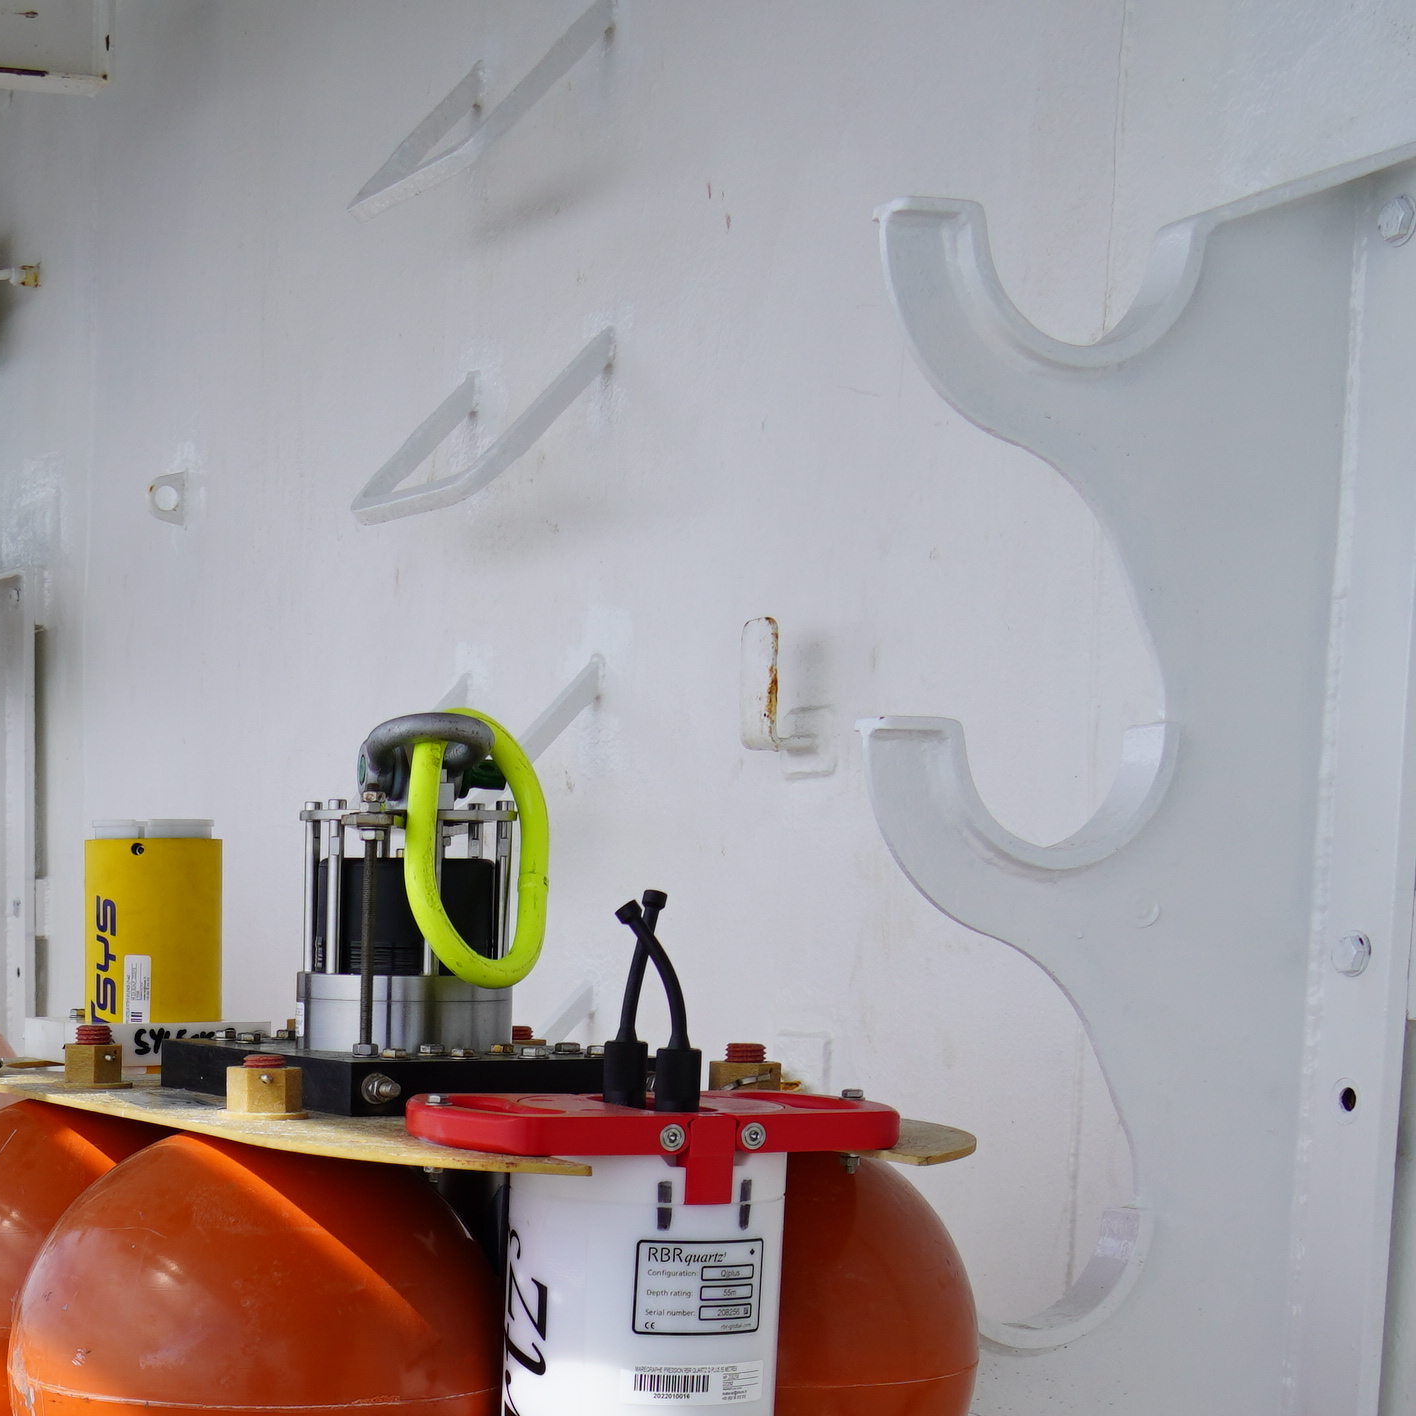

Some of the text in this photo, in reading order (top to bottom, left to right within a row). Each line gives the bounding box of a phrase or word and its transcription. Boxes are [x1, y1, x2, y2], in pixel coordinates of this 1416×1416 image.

[647, 1269, 699, 1278] Configuration:
[646, 1289, 694, 1299] Depth rating:
[722, 1288, 737, 1297] 55m
[666, 1309, 696, 1317] number:
